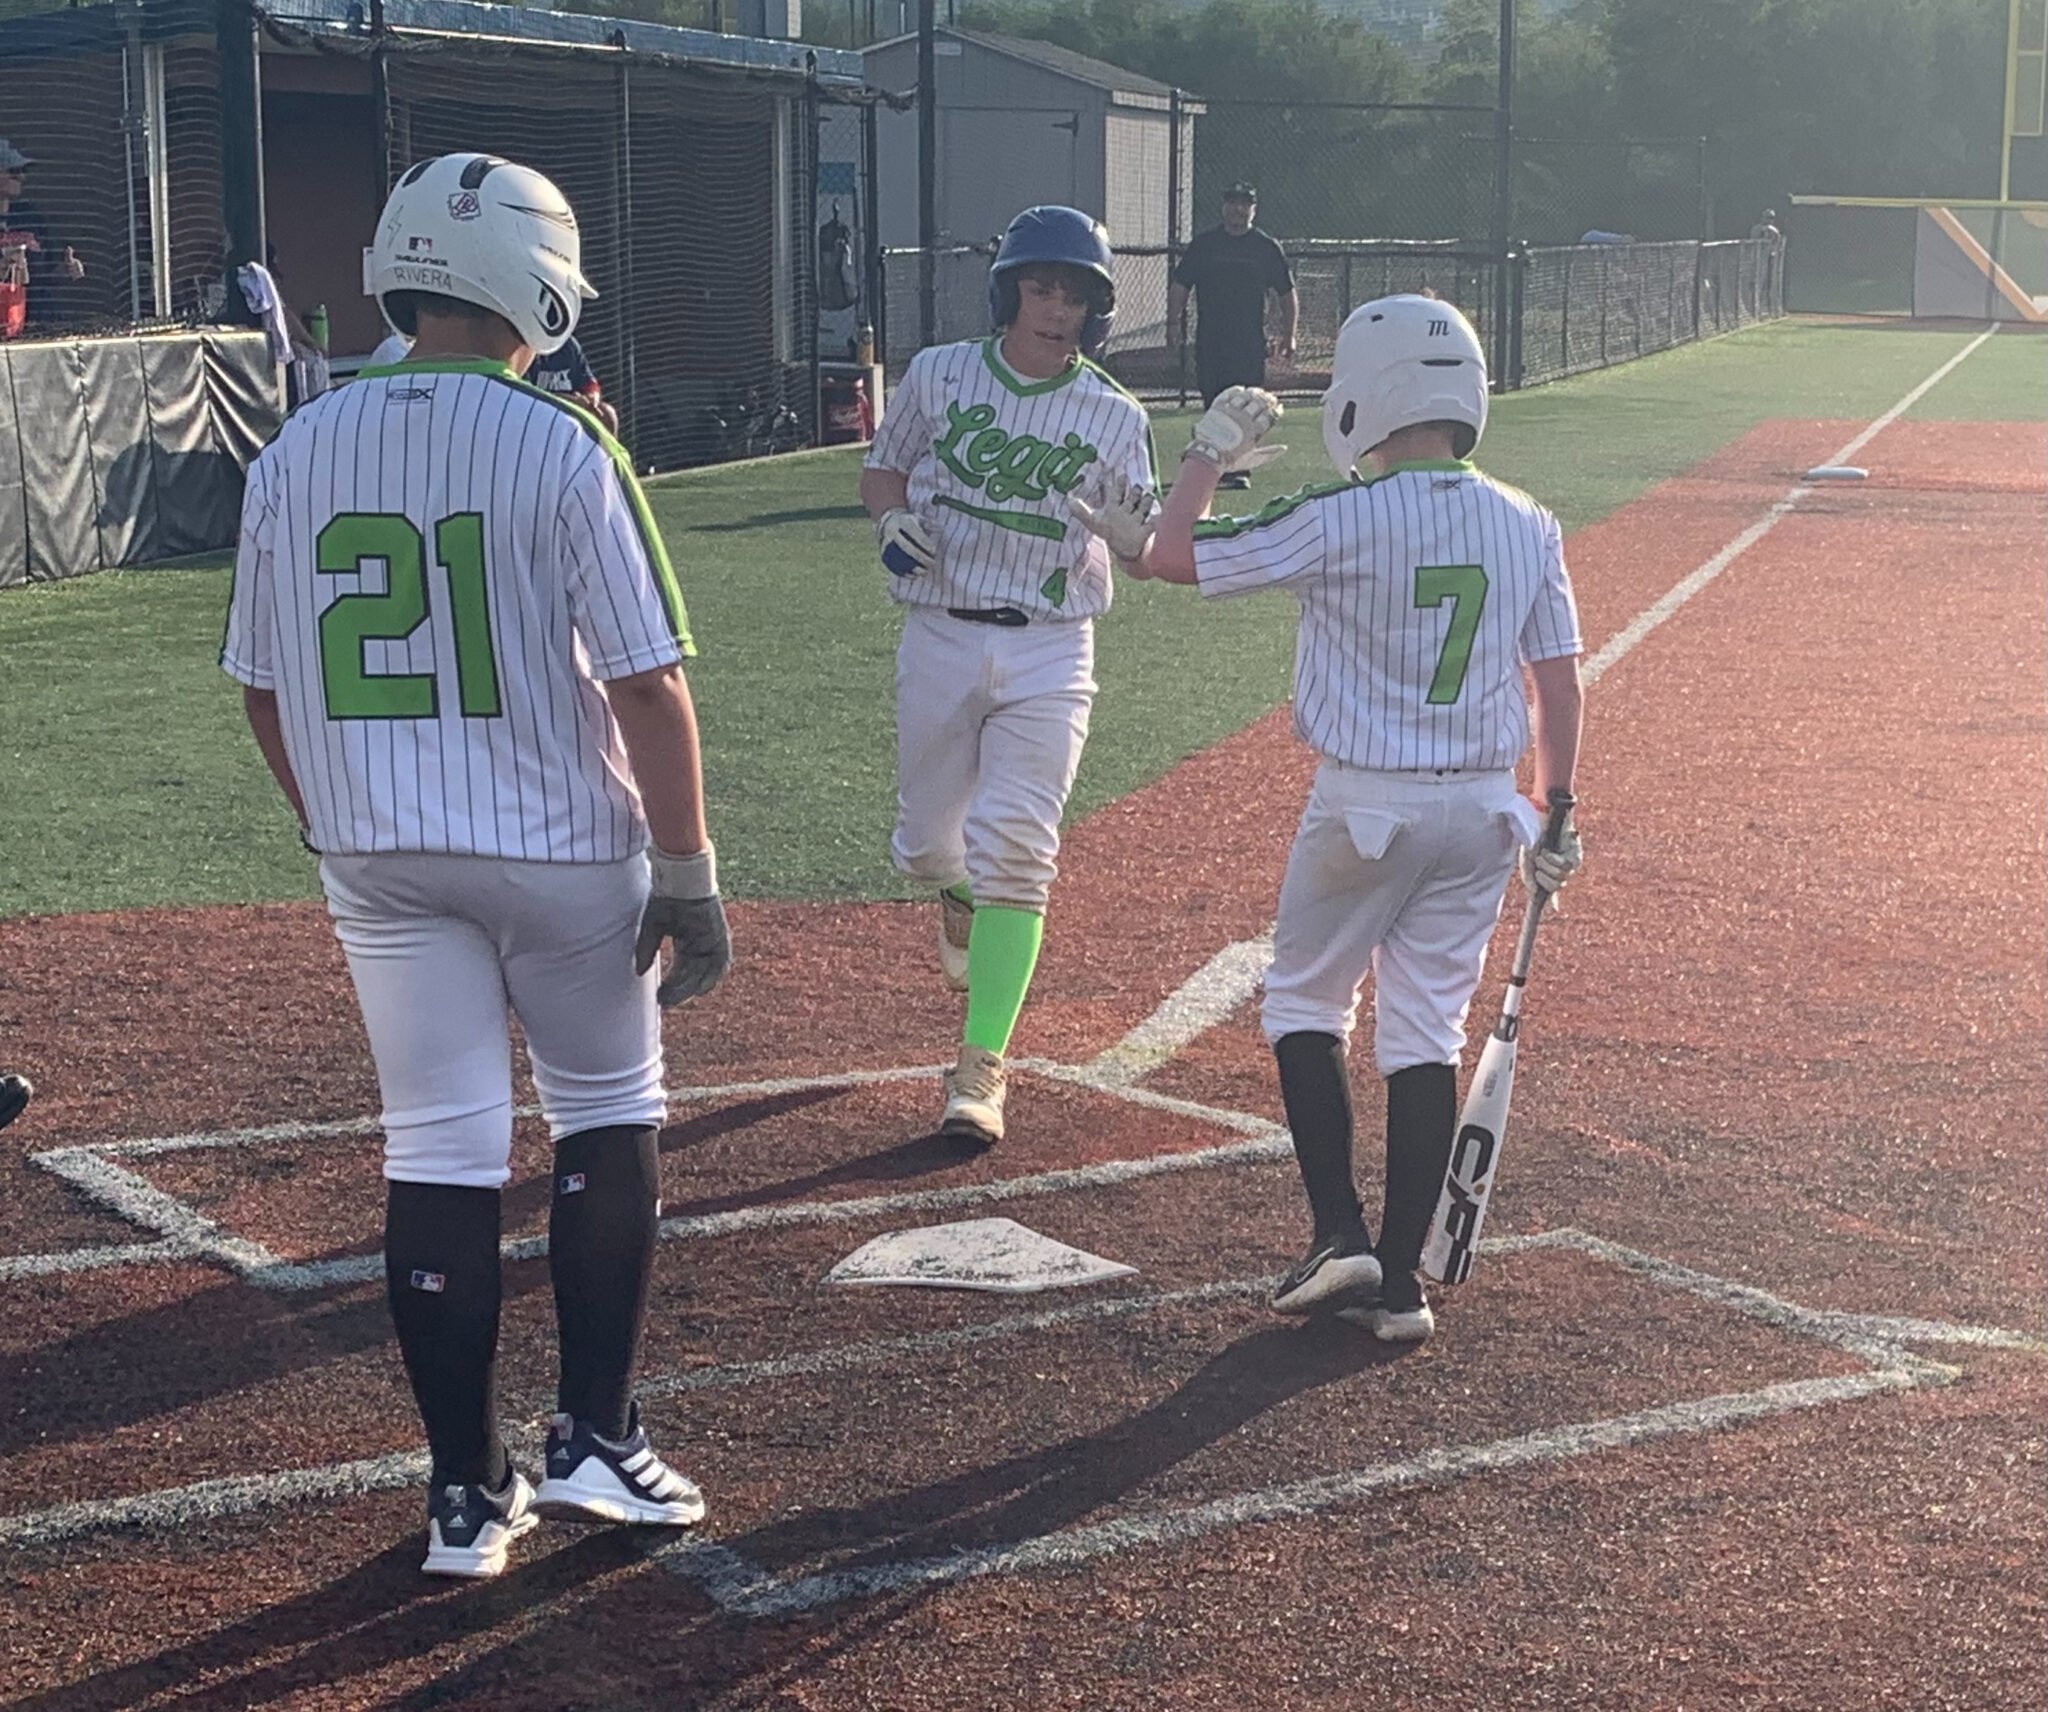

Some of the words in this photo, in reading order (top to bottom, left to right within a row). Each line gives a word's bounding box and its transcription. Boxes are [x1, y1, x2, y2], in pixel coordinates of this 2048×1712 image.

[394, 266, 452, 291] RIVERA
[934, 399, 1098, 502] Legit
[316, 512, 502, 720] 21
[1040, 567, 1068, 608] 4
[1414, 564, 1489, 705] 7
